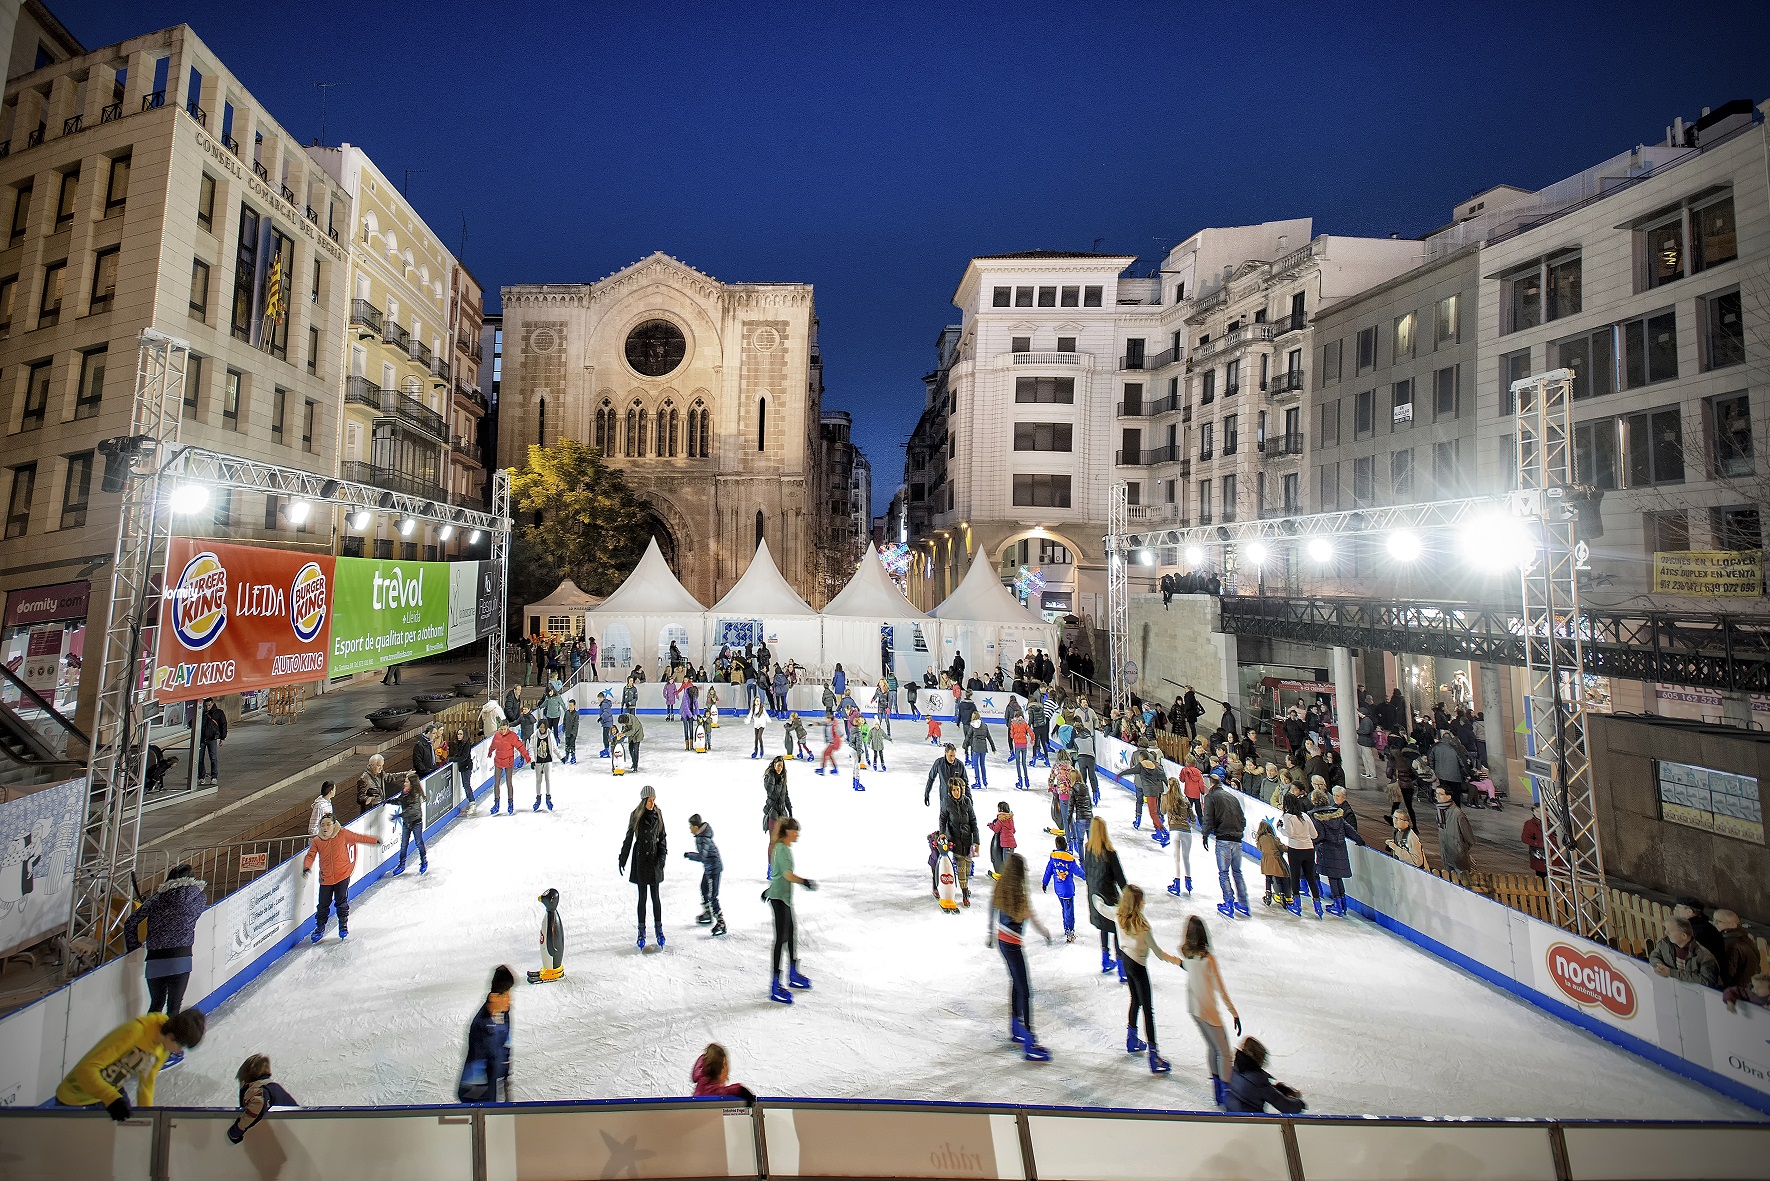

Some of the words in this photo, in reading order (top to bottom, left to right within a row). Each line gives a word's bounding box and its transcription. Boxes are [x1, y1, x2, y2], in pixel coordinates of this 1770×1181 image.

[195, 131, 242, 180] CONSELL
[247, 177, 296, 225] COMARCAL
[300, 219, 315, 240] DEL
[1681, 570, 1709, 578] DUPLEX
[1711, 570, 1723, 578] EN
[1725, 569, 1756, 578] VENTA
[1695, 558, 1707, 566] EN
[236, 582, 286, 617] LLEIDA
[295, 577, 325, 605] BURGER
[1705, 583, 1721, 593] 639
[1723, 583, 1739, 592] 072
[179, 586, 225, 631] KING
[295, 590, 325, 626] KING
[334, 637, 364, 659] Esport
[365, 633, 374, 650] de
[375, 630, 404, 653] qualitat
[404, 631, 416, 648] per
[155, 662, 196, 691] PLAY
[197, 659, 236, 686] KING
[1662, 691, 1679, 700] 605
[1682, 693, 1698, 702] 162
[1700, 696, 1719, 705] 523
[1555, 954, 1627, 1005] nocilla
[1564, 979, 1571, 988] la
[1728, 1055, 1764, 1080] Obra
